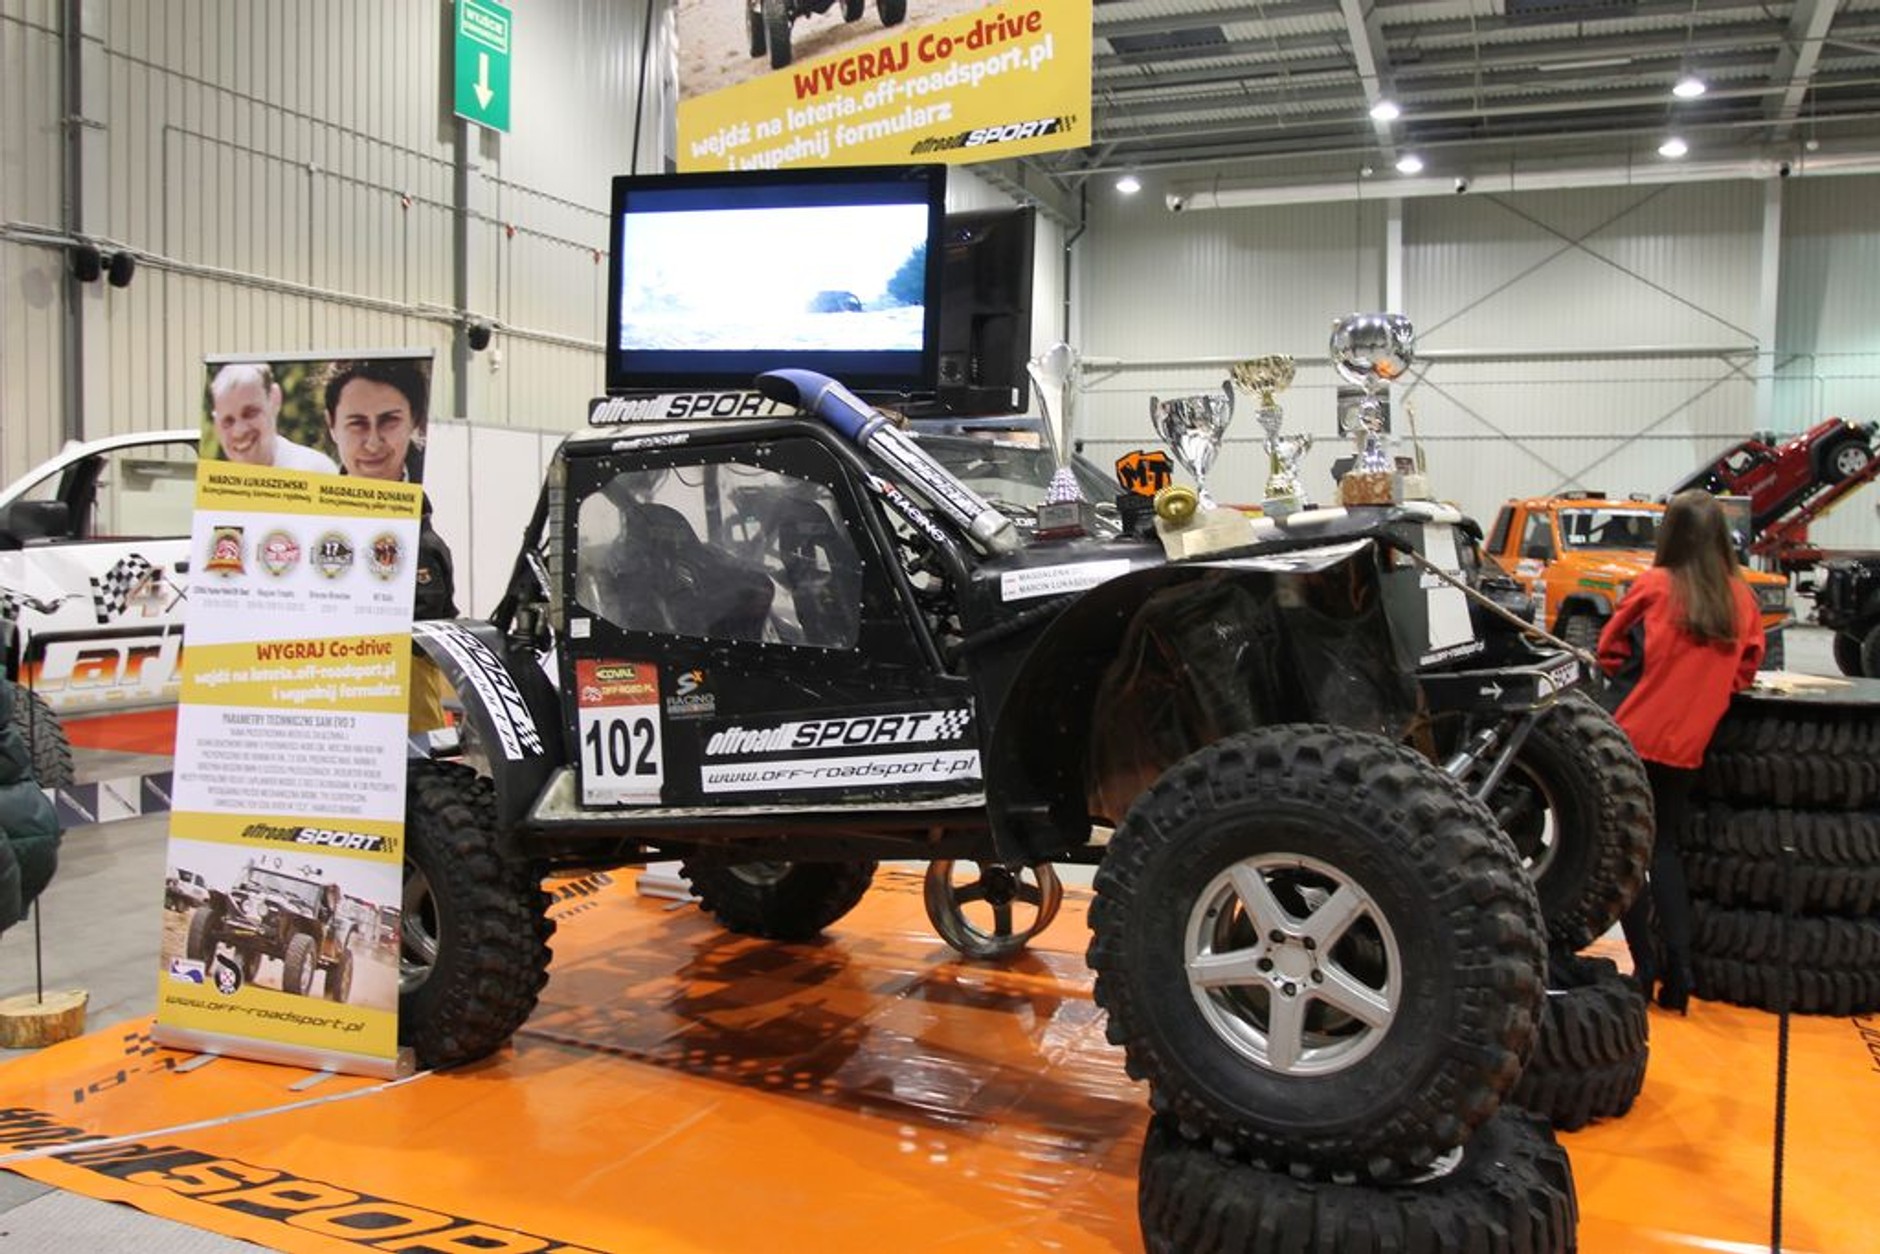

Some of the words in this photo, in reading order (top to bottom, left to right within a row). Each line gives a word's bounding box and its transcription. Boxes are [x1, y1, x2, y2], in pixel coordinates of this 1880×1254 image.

[793, 46, 910, 100] WYGRAJ
[918, 10, 1043, 64] Co-drive
[691, 126, 752, 158] wejdź
[757, 116, 782, 141] na
[787, 32, 1055, 132] loteria.off-roadsport.pl
[834, 101, 953, 148] formularz
[964, 118, 1056, 147] SPORT
[256, 643, 325, 661] WYGRAJ
[329, 640, 393, 658] Co-drive
[586, 717, 657, 777] 102
[791, 714, 932, 749] SPORT
[708, 756, 976, 784] www.off-roadsport.pl
[295, 828, 381, 851] SPORT
[165, 995, 365, 1033] www.off-roadsport.pl
